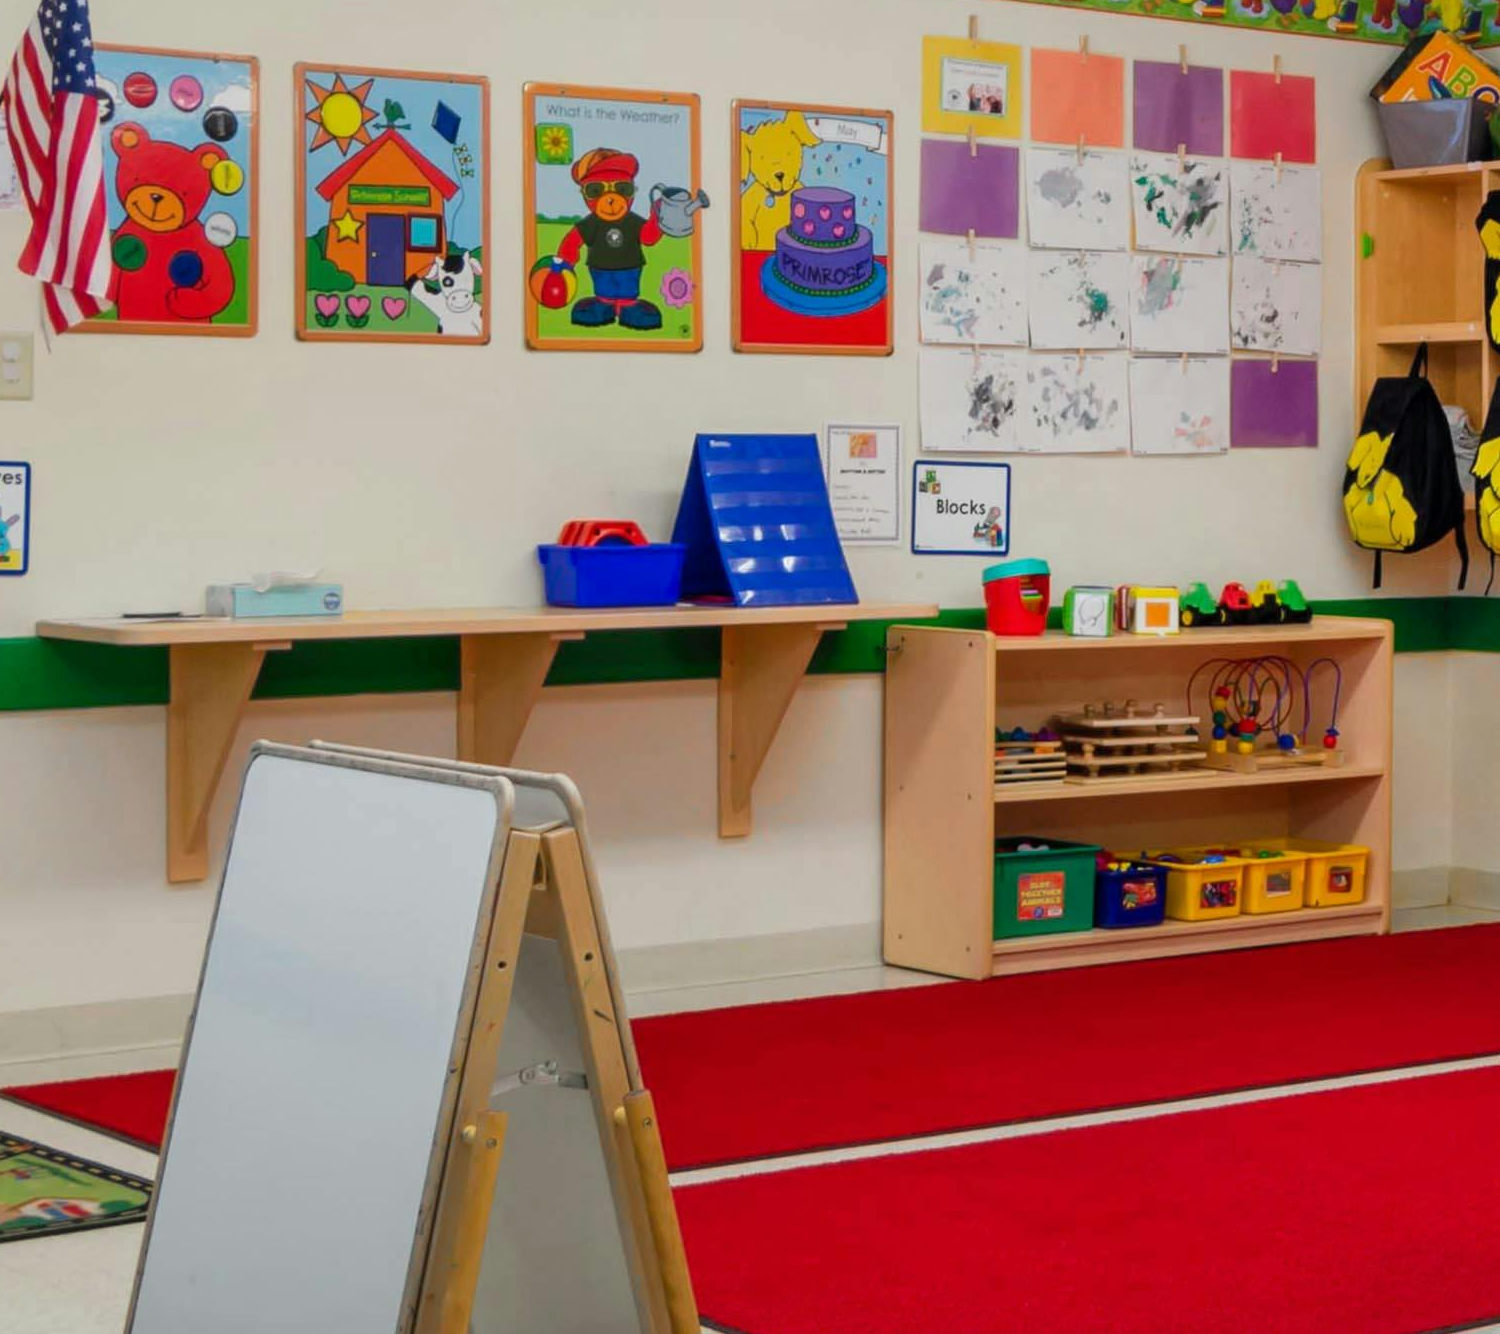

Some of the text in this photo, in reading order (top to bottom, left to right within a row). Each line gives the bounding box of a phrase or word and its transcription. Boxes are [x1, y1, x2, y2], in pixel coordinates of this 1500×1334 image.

[545, 104, 581, 117] What
[595, 109, 616, 121] the
[619, 108, 680, 124] Weather?
[936, 498, 986, 515] Blocks
